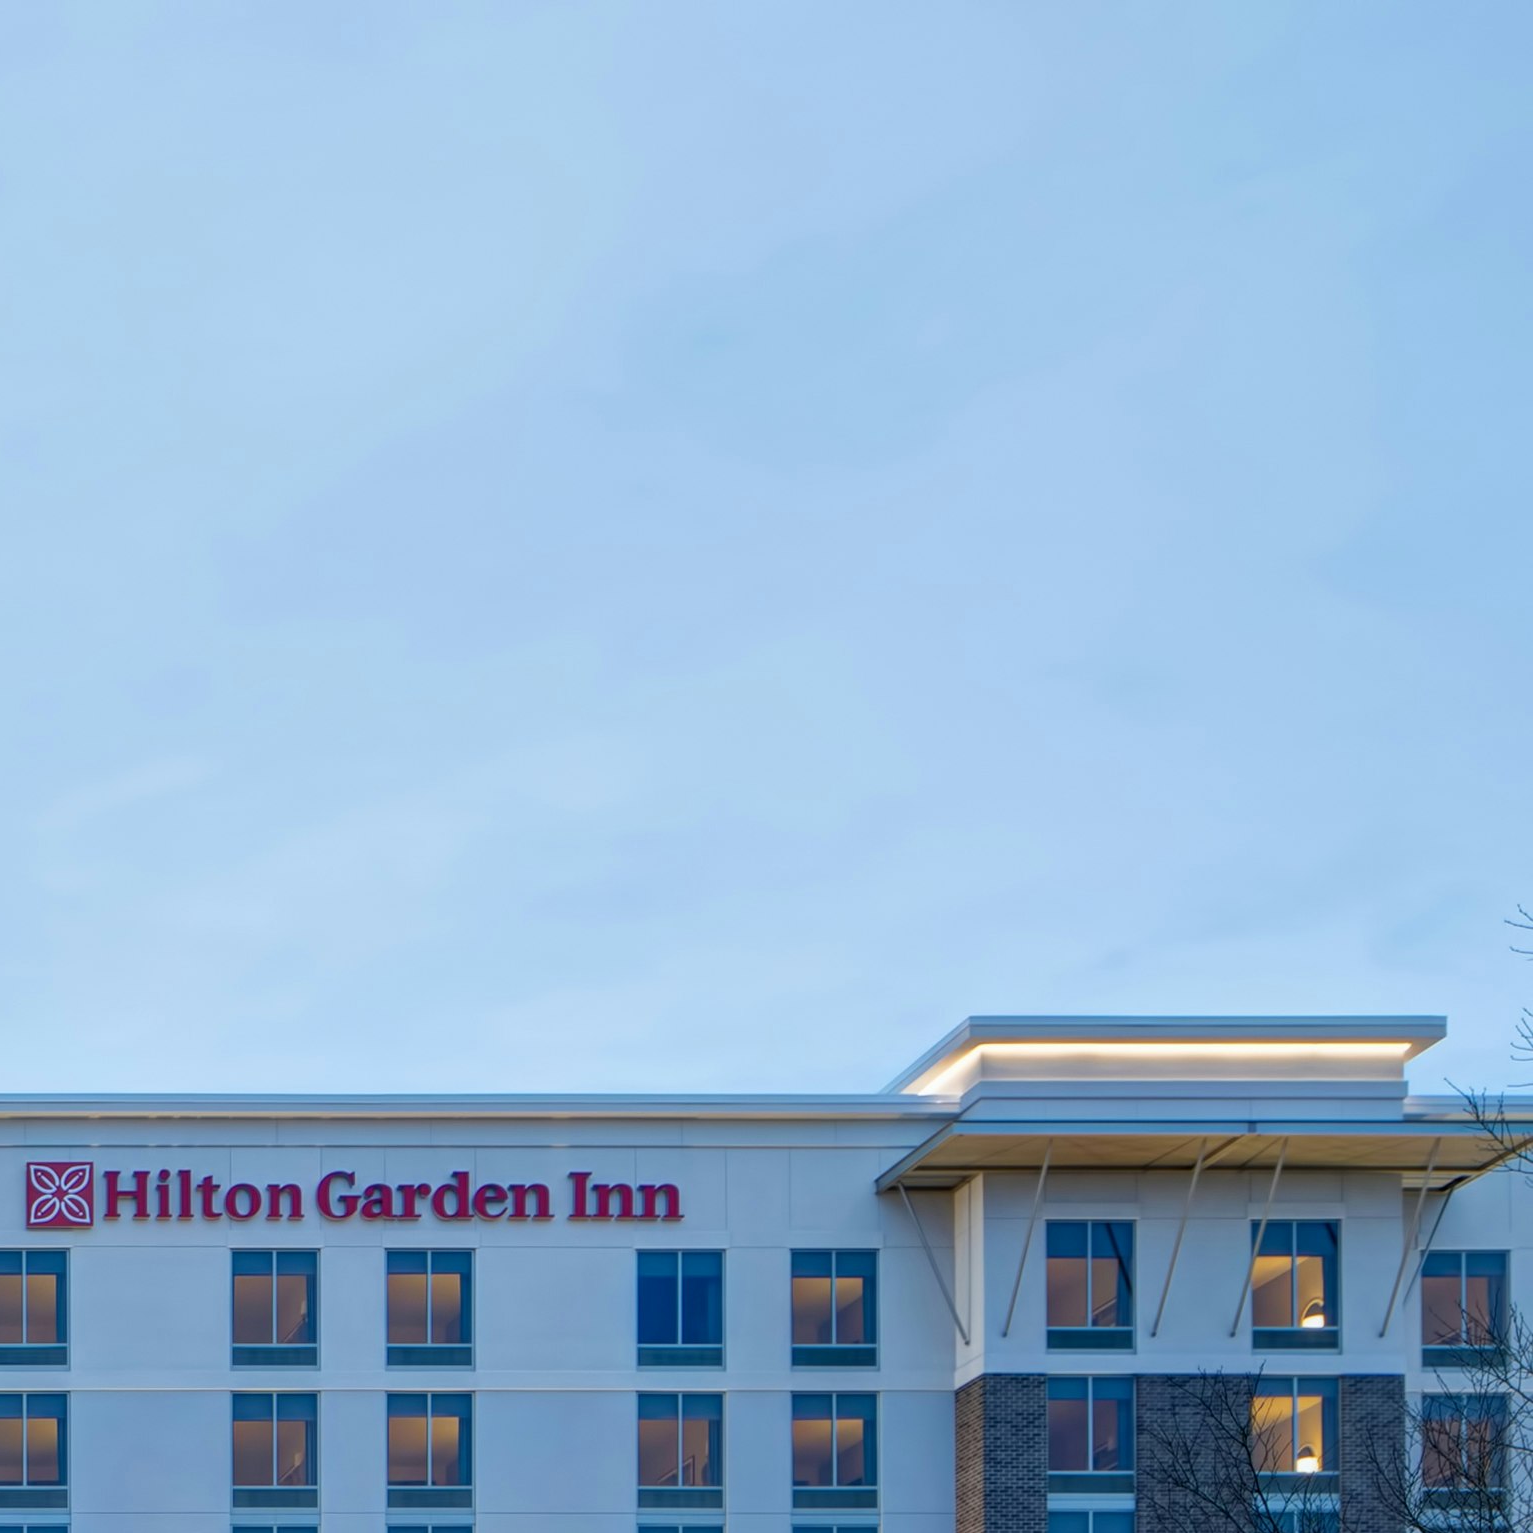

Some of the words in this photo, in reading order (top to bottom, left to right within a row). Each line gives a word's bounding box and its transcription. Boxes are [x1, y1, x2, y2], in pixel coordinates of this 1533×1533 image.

[103, 1169, 304, 1222] Hilton
[317, 1170, 554, 1222] Garden
[568, 1171, 684, 1222] Inn
